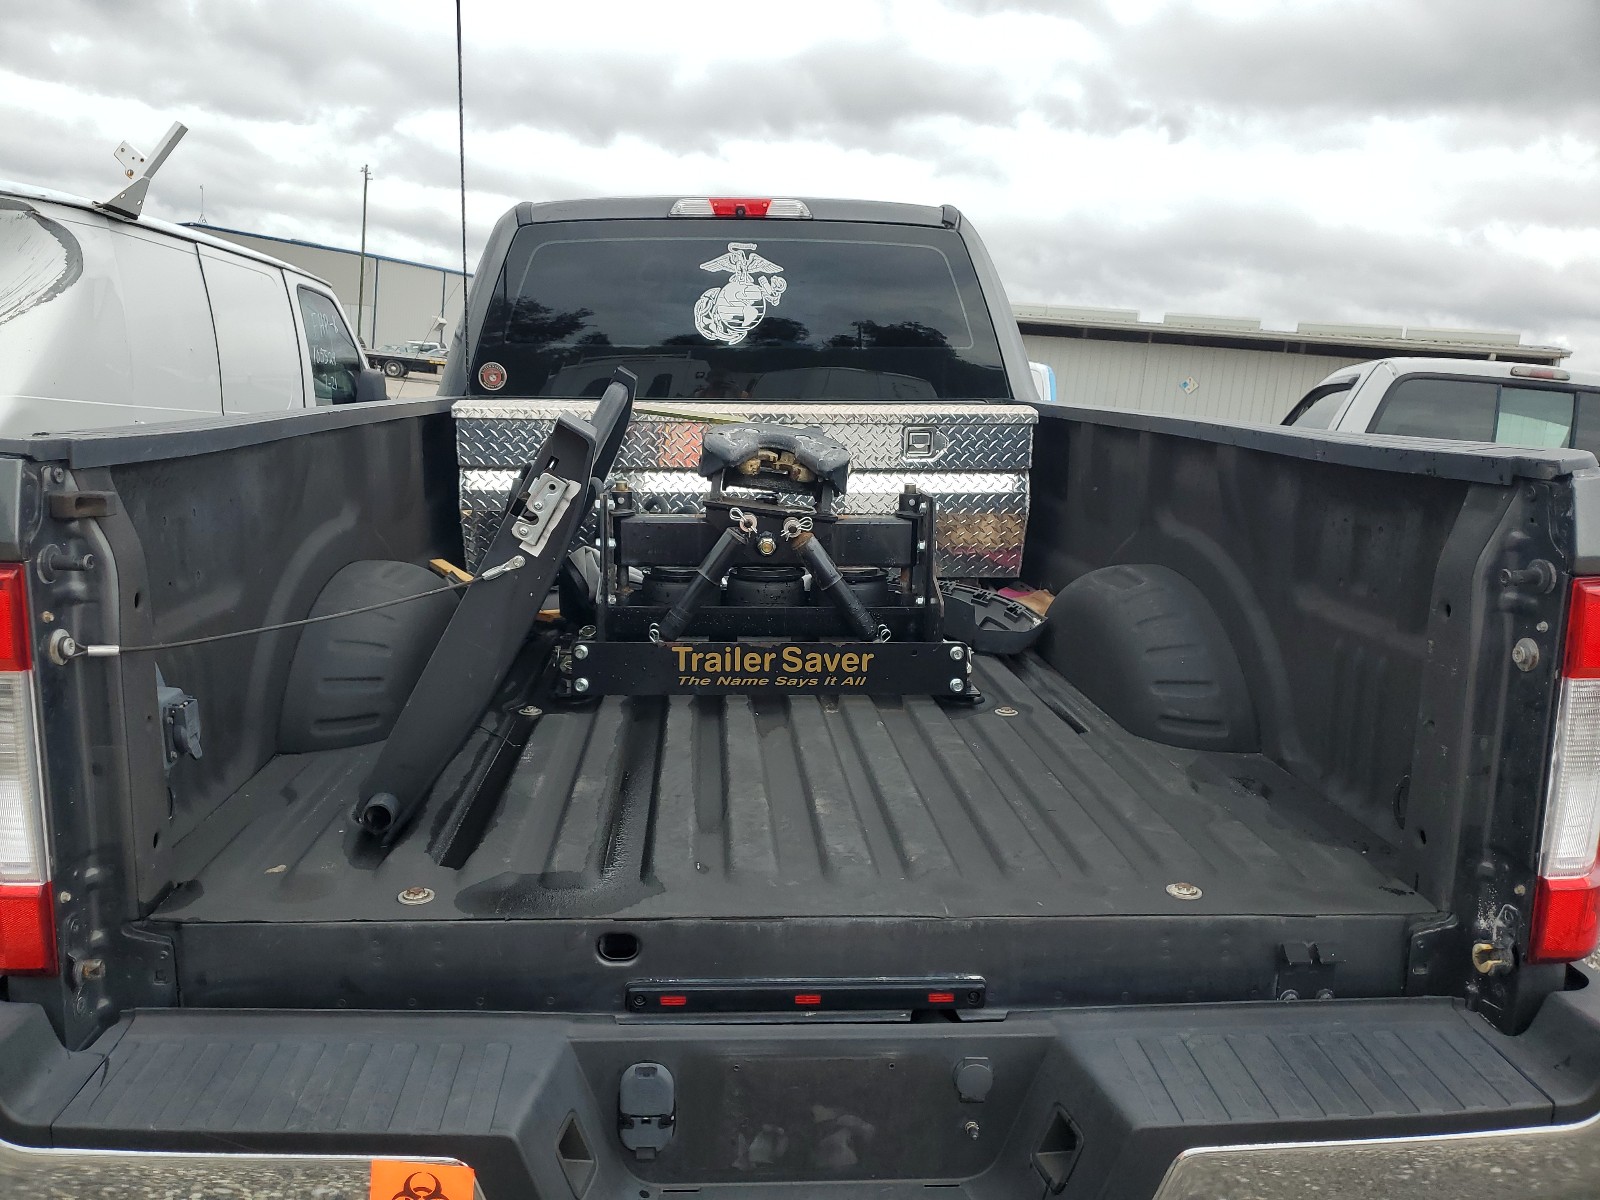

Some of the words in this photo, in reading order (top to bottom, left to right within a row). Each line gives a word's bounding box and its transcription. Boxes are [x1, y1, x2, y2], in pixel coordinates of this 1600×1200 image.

[671, 646, 777, 673] Trailer
[782, 646, 875, 673] Saver
[678, 676, 712, 686] The
[716, 676, 770, 686] Name
[775, 676, 819, 688] Says
[823, 676, 838, 686] It
[840, 676, 868, 686] All
